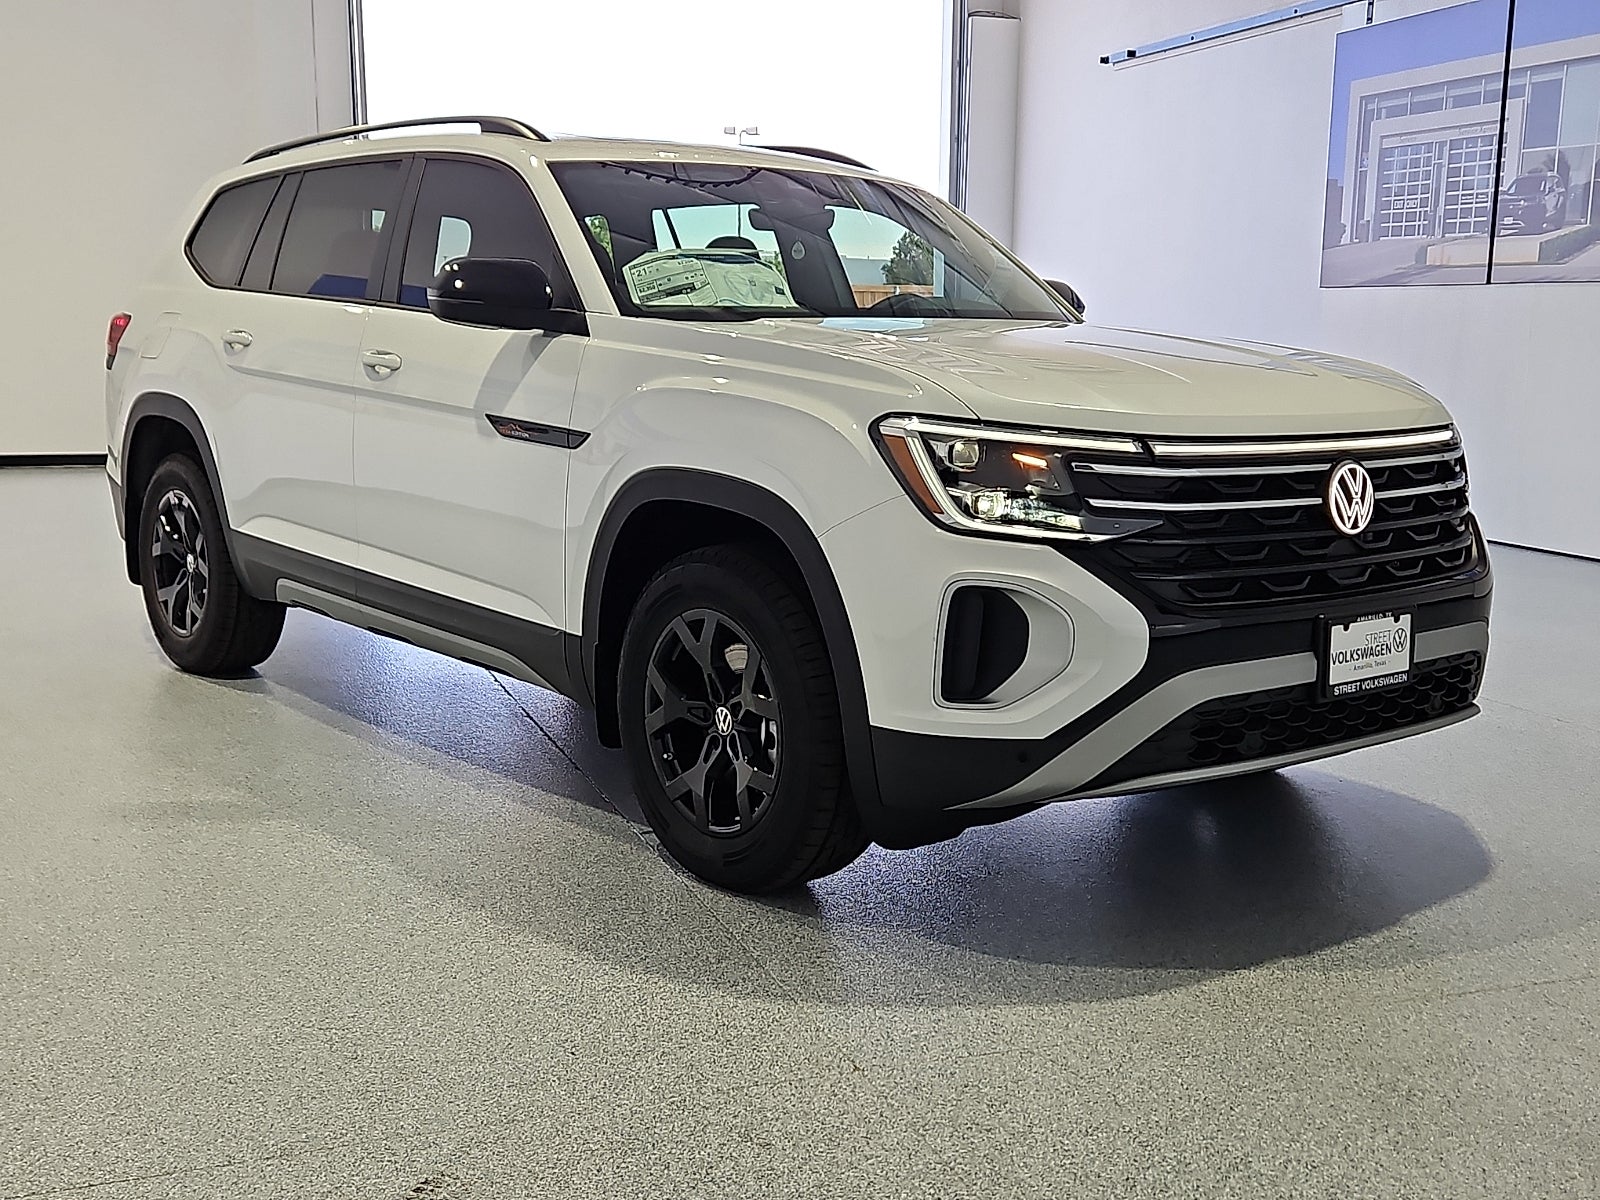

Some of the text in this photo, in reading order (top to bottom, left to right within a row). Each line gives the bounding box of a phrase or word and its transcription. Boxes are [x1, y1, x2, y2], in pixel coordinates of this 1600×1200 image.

[1365, 629, 1392, 646] STREET
[1331, 641, 1392, 665] VOLKSWAGEN
[1333, 672, 1408, 695] STREET VOLKSWAGEN
